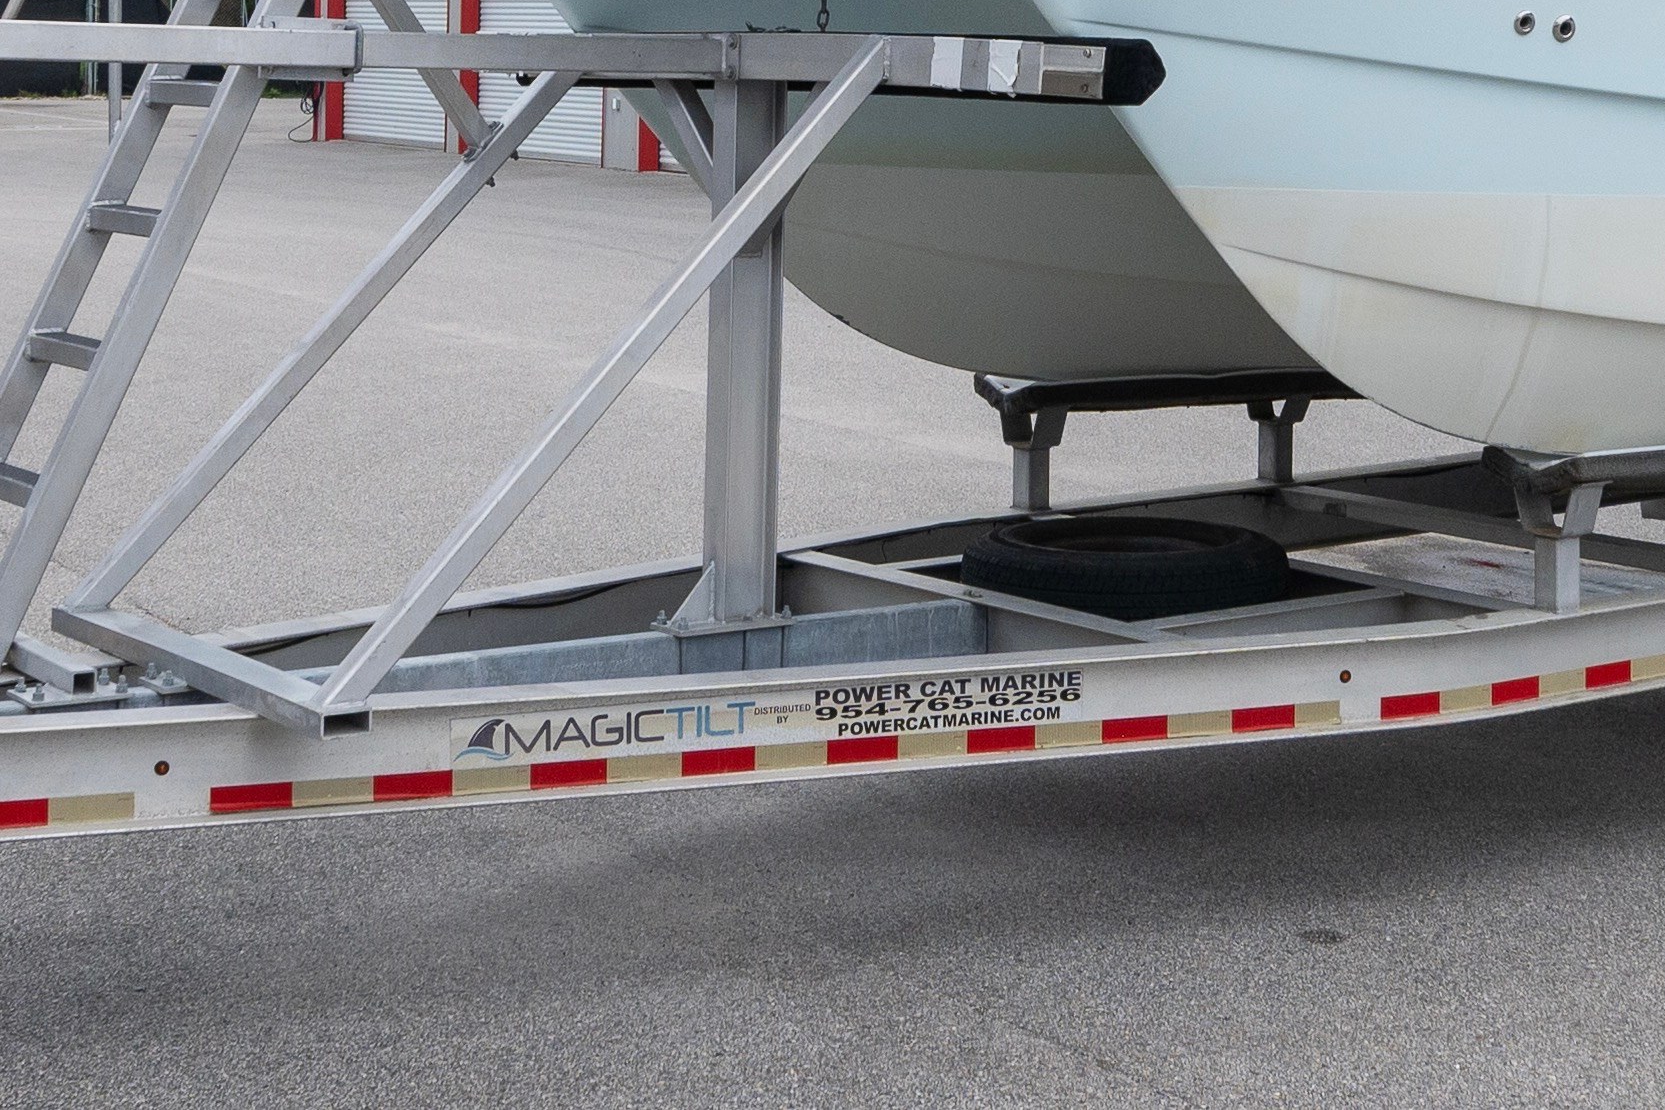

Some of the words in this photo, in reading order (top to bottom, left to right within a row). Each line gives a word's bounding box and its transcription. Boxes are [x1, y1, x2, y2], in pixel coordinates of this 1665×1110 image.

[814, 683, 911, 706] POWER
[920, 678, 971, 698] CAT
[980, 670, 1083, 694] MARINE
[815, 687, 1082, 721] 954-765-6256
[754, 703, 811, 717] DISTRIBUTED
[776, 715, 790, 724] BY
[838, 706, 1061, 737] POWERCATMARINE.COM
[504, 701, 756, 756] MAGICTILT
